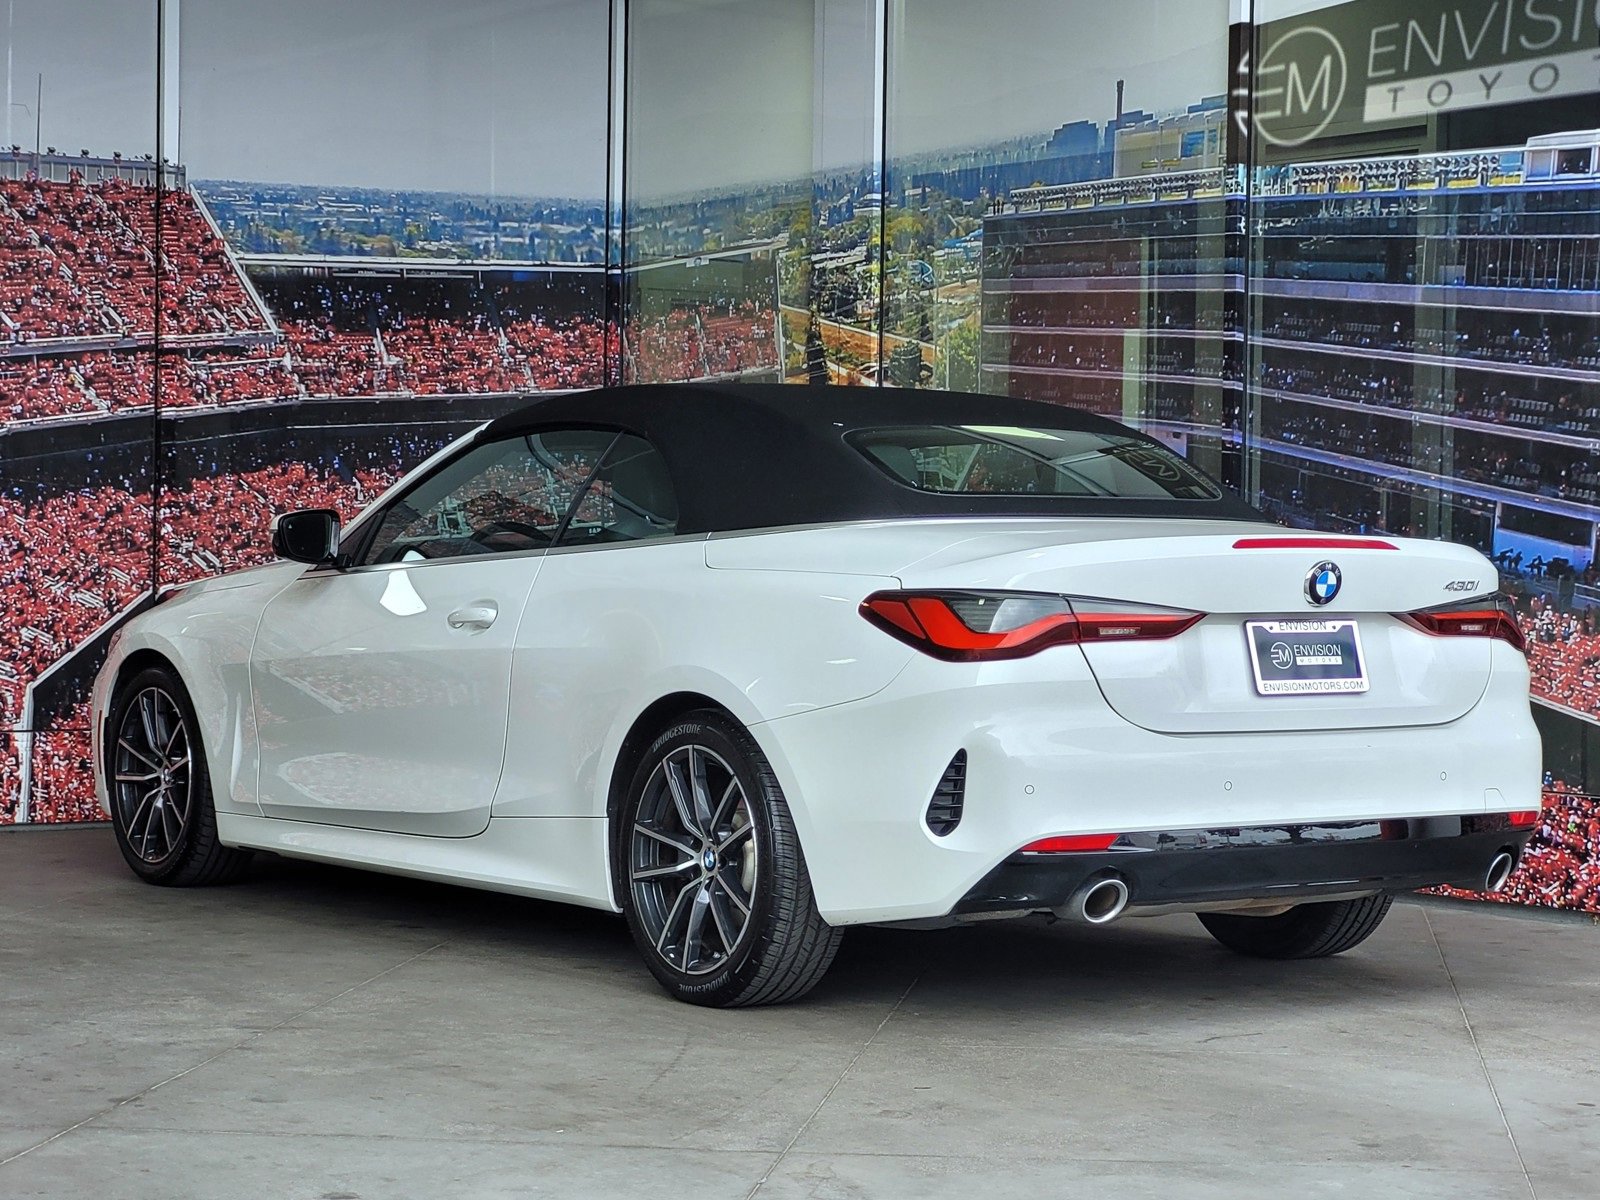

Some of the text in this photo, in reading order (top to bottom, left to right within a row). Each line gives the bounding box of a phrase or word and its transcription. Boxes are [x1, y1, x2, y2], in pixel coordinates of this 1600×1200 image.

[1368, 0, 1600, 78] ENVISI
[1313, 562, 1341, 577] BMW
[1279, 621, 1327, 631] ENVISION
[1293, 643, 1341, 656] ENVISION
[1263, 680, 1364, 692] ENVISIONMOTORS.COM
[652, 723, 701, 753] BRIDGESTONE
